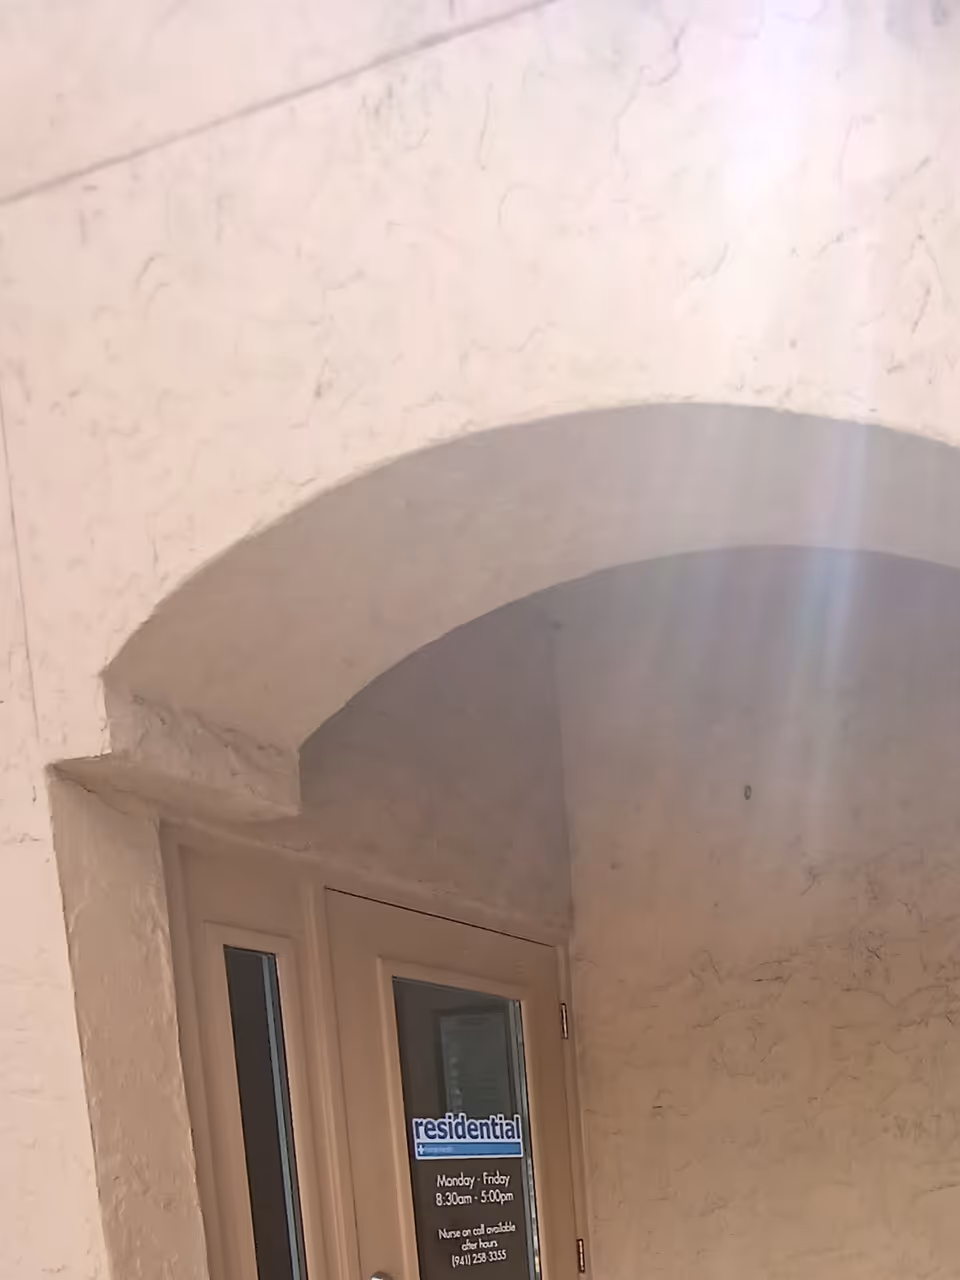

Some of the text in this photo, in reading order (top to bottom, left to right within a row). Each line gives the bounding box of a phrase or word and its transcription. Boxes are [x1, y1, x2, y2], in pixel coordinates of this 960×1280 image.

[413, 1114, 521, 1140] residential
[436, 1171, 475, 1190] Monday
[482, 1169, 510, 1188] Friday
[435, 1191, 473, 1206] 8:30am
[480, 1188, 514, 1205] 5:00pm
[438, 1221, 516, 1240] Nurse on call available
[461, 1237, 498, 1251] after hours
[451, 1253, 471, 1269] (941)
